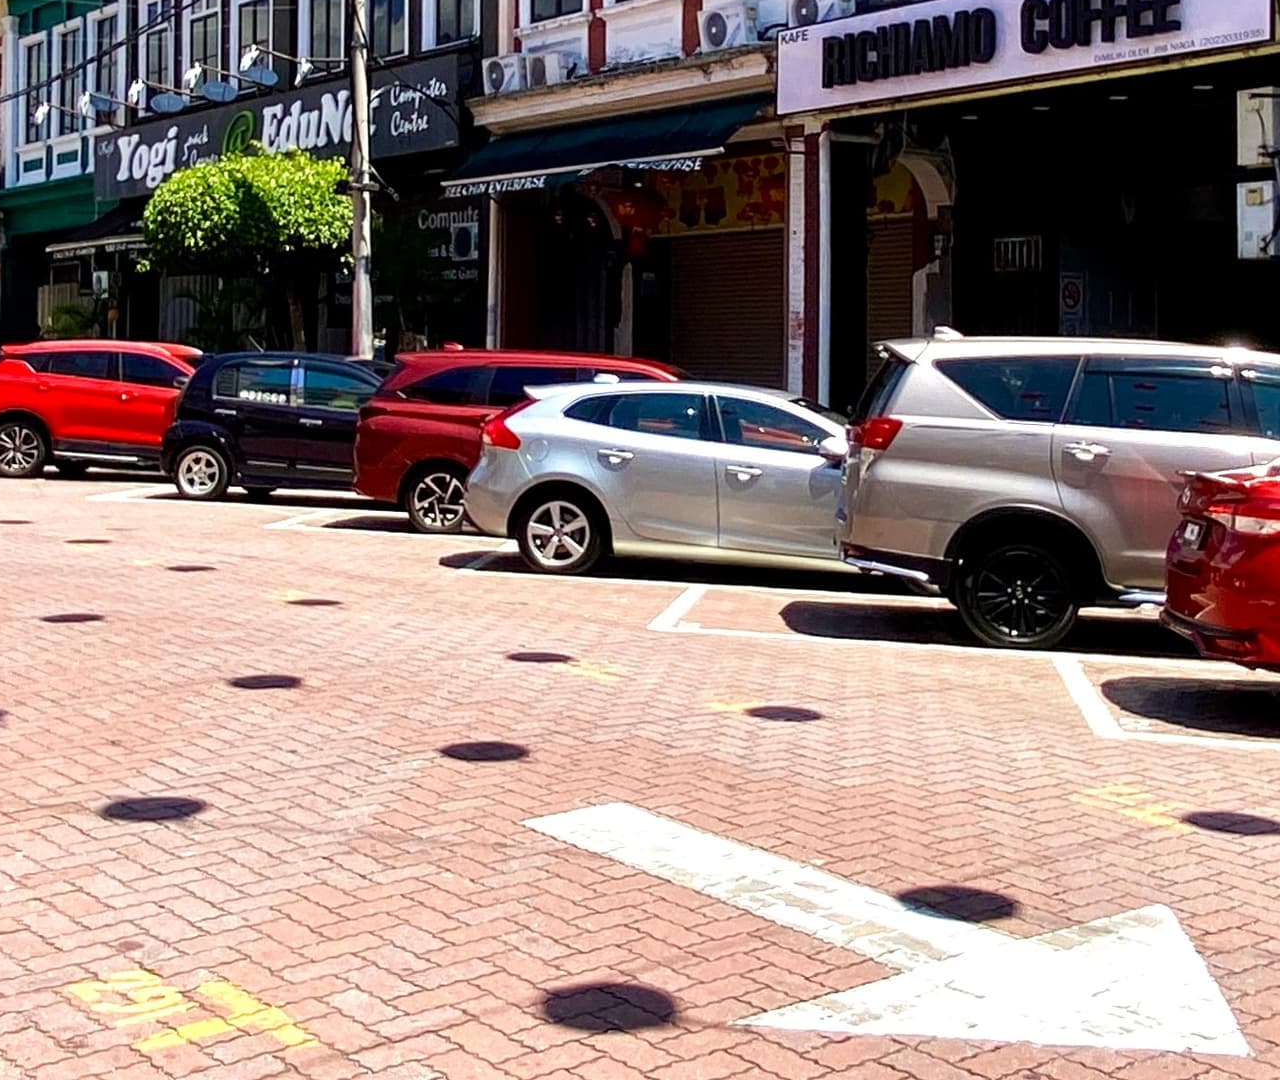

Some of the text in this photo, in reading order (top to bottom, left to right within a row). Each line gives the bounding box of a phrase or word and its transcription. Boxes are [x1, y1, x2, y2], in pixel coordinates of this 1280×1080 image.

[780, 30, 809, 46] KAFE
[822, 7, 997, 89] RICHIAMO
[390, 111, 429, 136] Centre
[116, 126, 178, 188] Yogi
